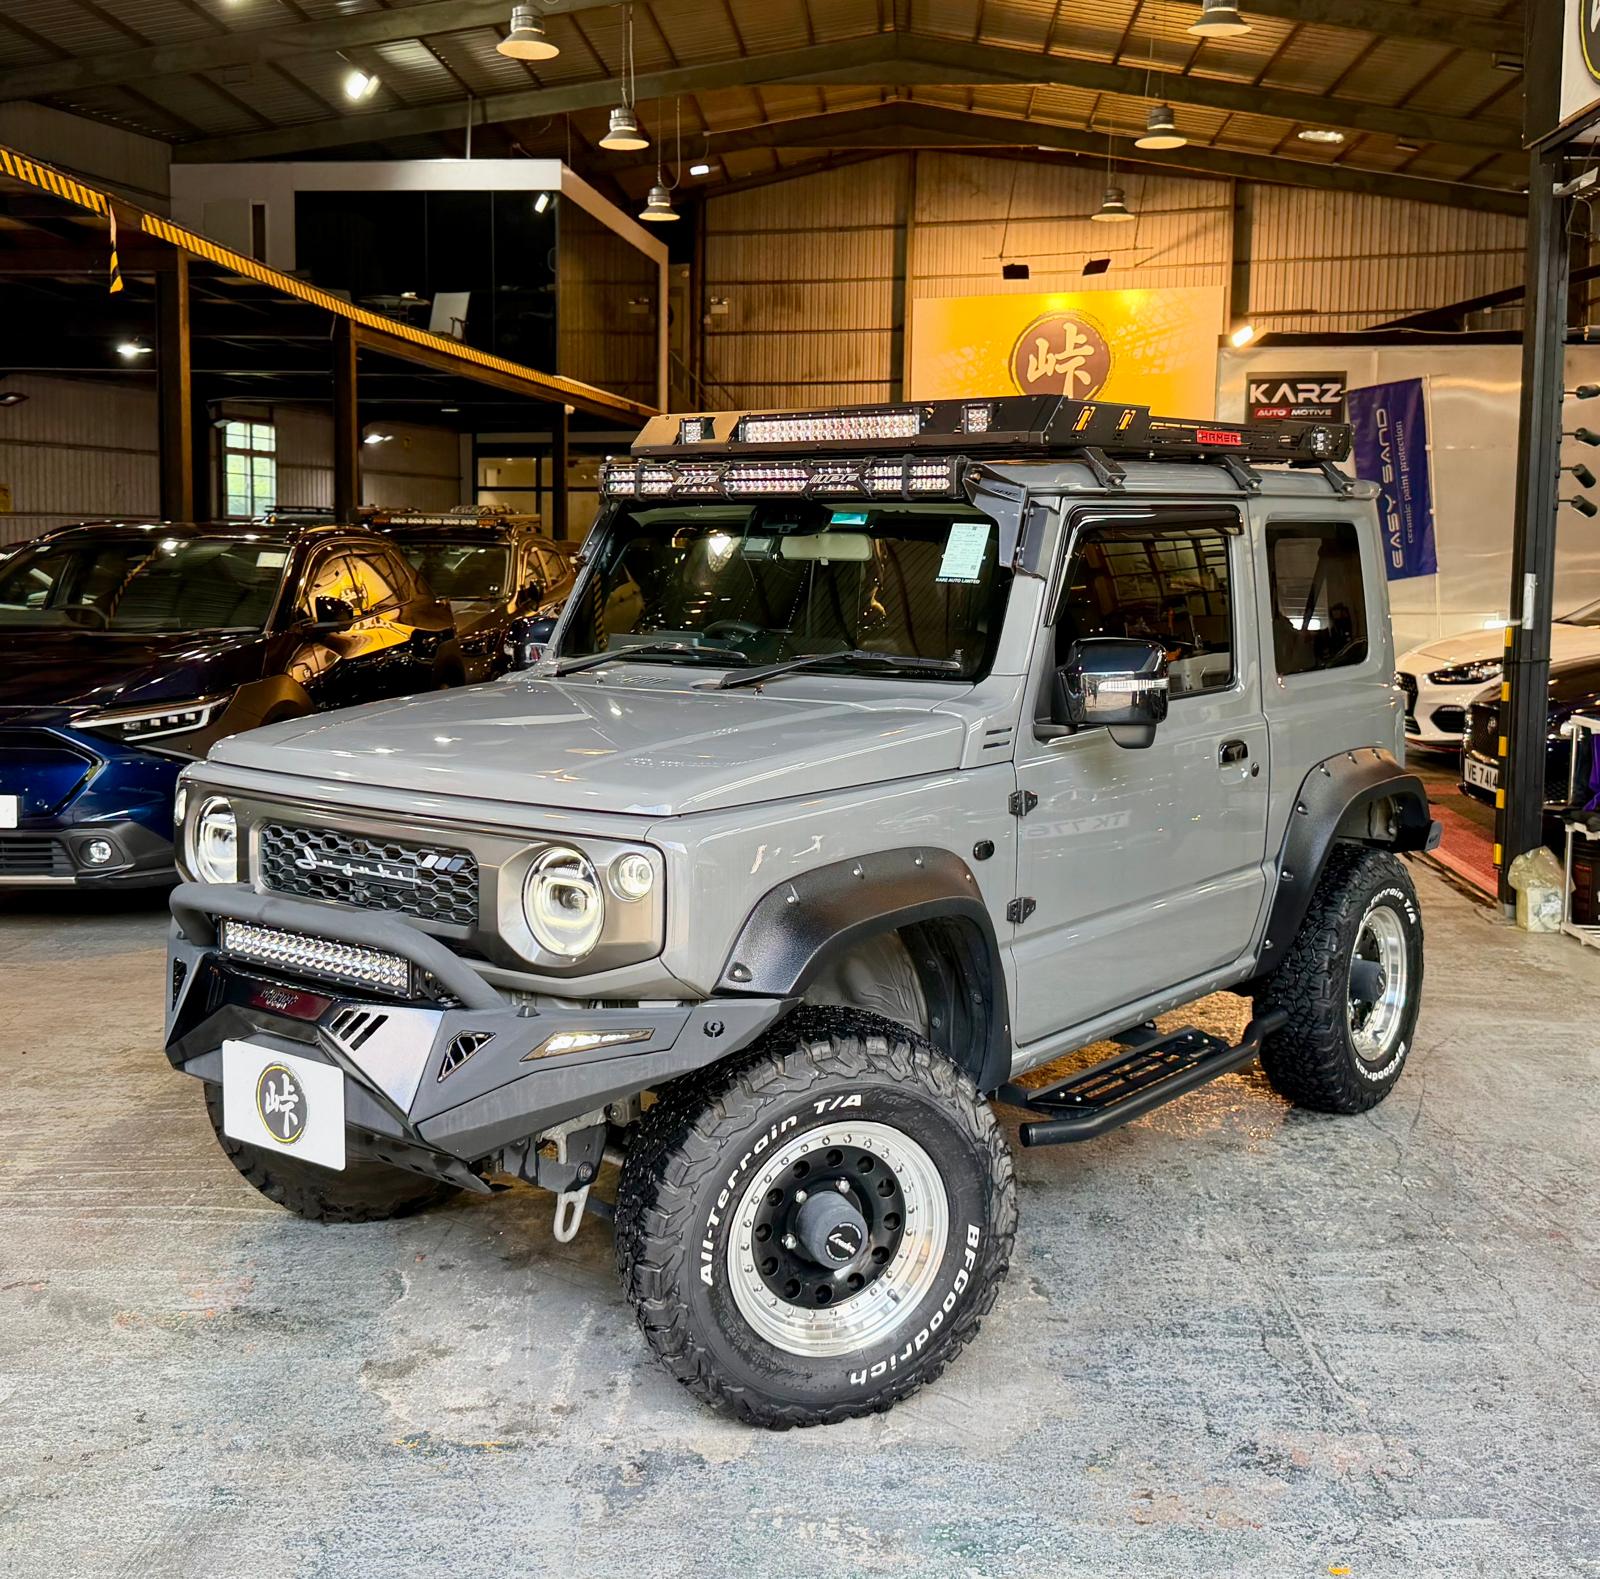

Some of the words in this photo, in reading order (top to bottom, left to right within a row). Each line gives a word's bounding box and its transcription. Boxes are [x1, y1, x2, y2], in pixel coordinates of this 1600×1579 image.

[1027, 322, 1095, 399] 峠
[1249, 382, 1344, 404] KARZ
[1256, 408, 1288, 417] AUTO
[1291, 408, 1332, 417] MOTIVE
[1376, 408, 1393, 484] SAND
[1395, 420, 1410, 472] protection
[1401, 475, 1413, 503] paint
[1384, 494, 1404, 569] EASY
[1404, 503, 1414, 544] ceramic
[265, 1073, 299, 1138] 峠
[701, 1115, 798, 1286] All-Terrain
[813, 1094, 862, 1115] T/A
[850, 1223, 981, 1386] BFGoodrich
